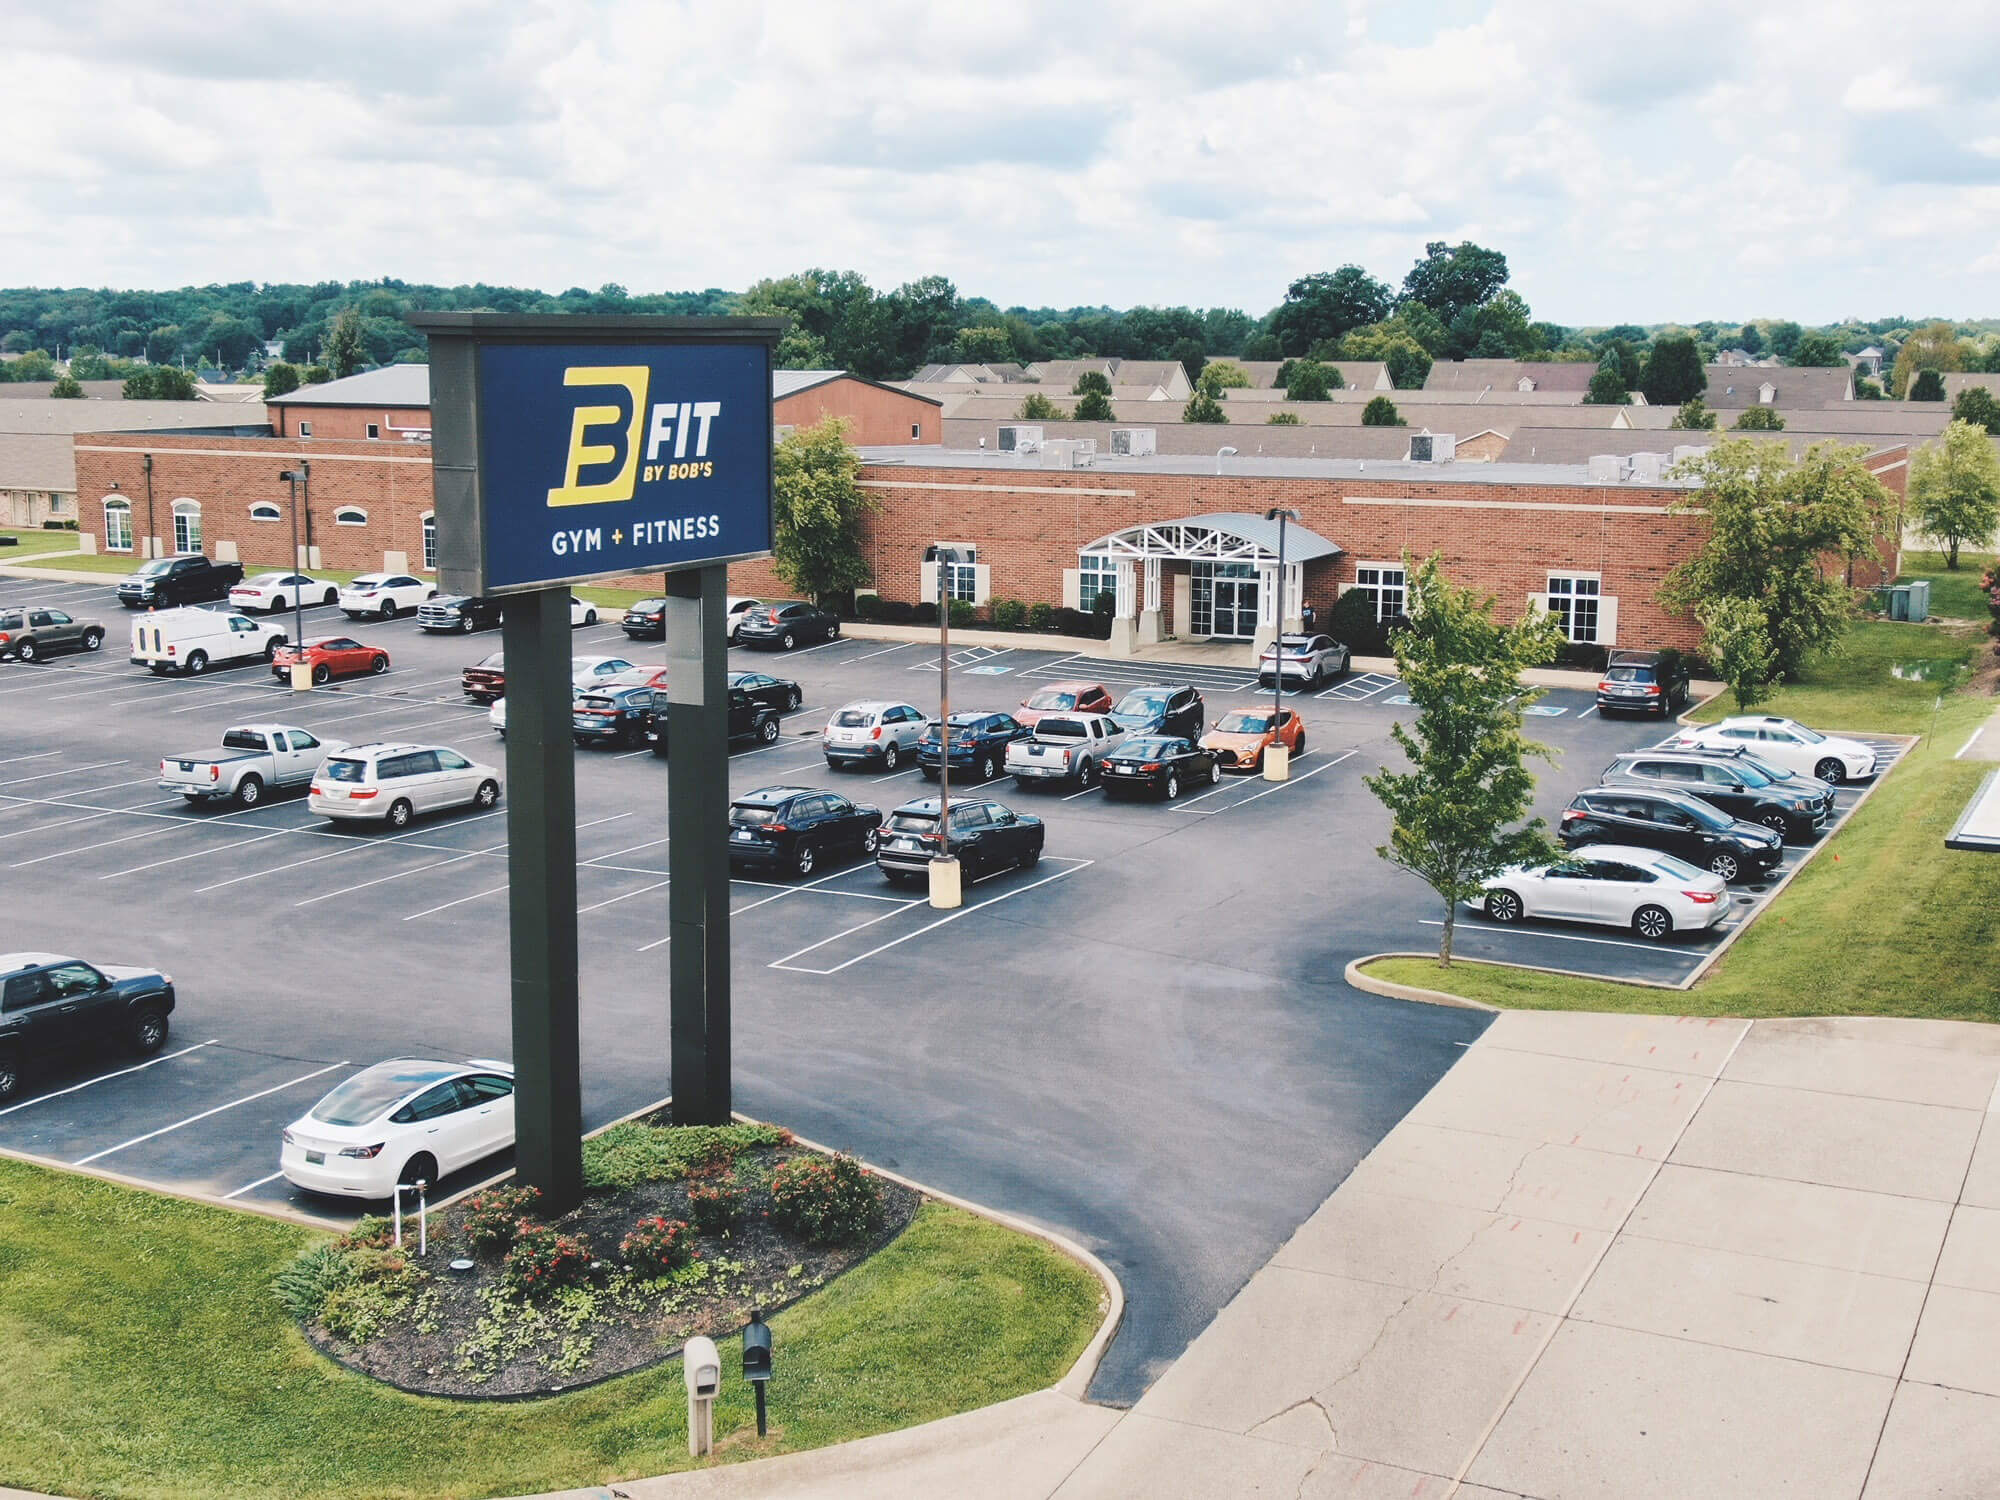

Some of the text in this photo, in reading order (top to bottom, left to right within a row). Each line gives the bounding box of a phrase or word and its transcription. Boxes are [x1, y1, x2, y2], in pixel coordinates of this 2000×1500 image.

[646, 402, 721, 460] FIT
[643, 462, 713, 482] BY BOB'S
[552, 528, 602, 555] GYM
[633, 515, 720, 545] FITNESS
